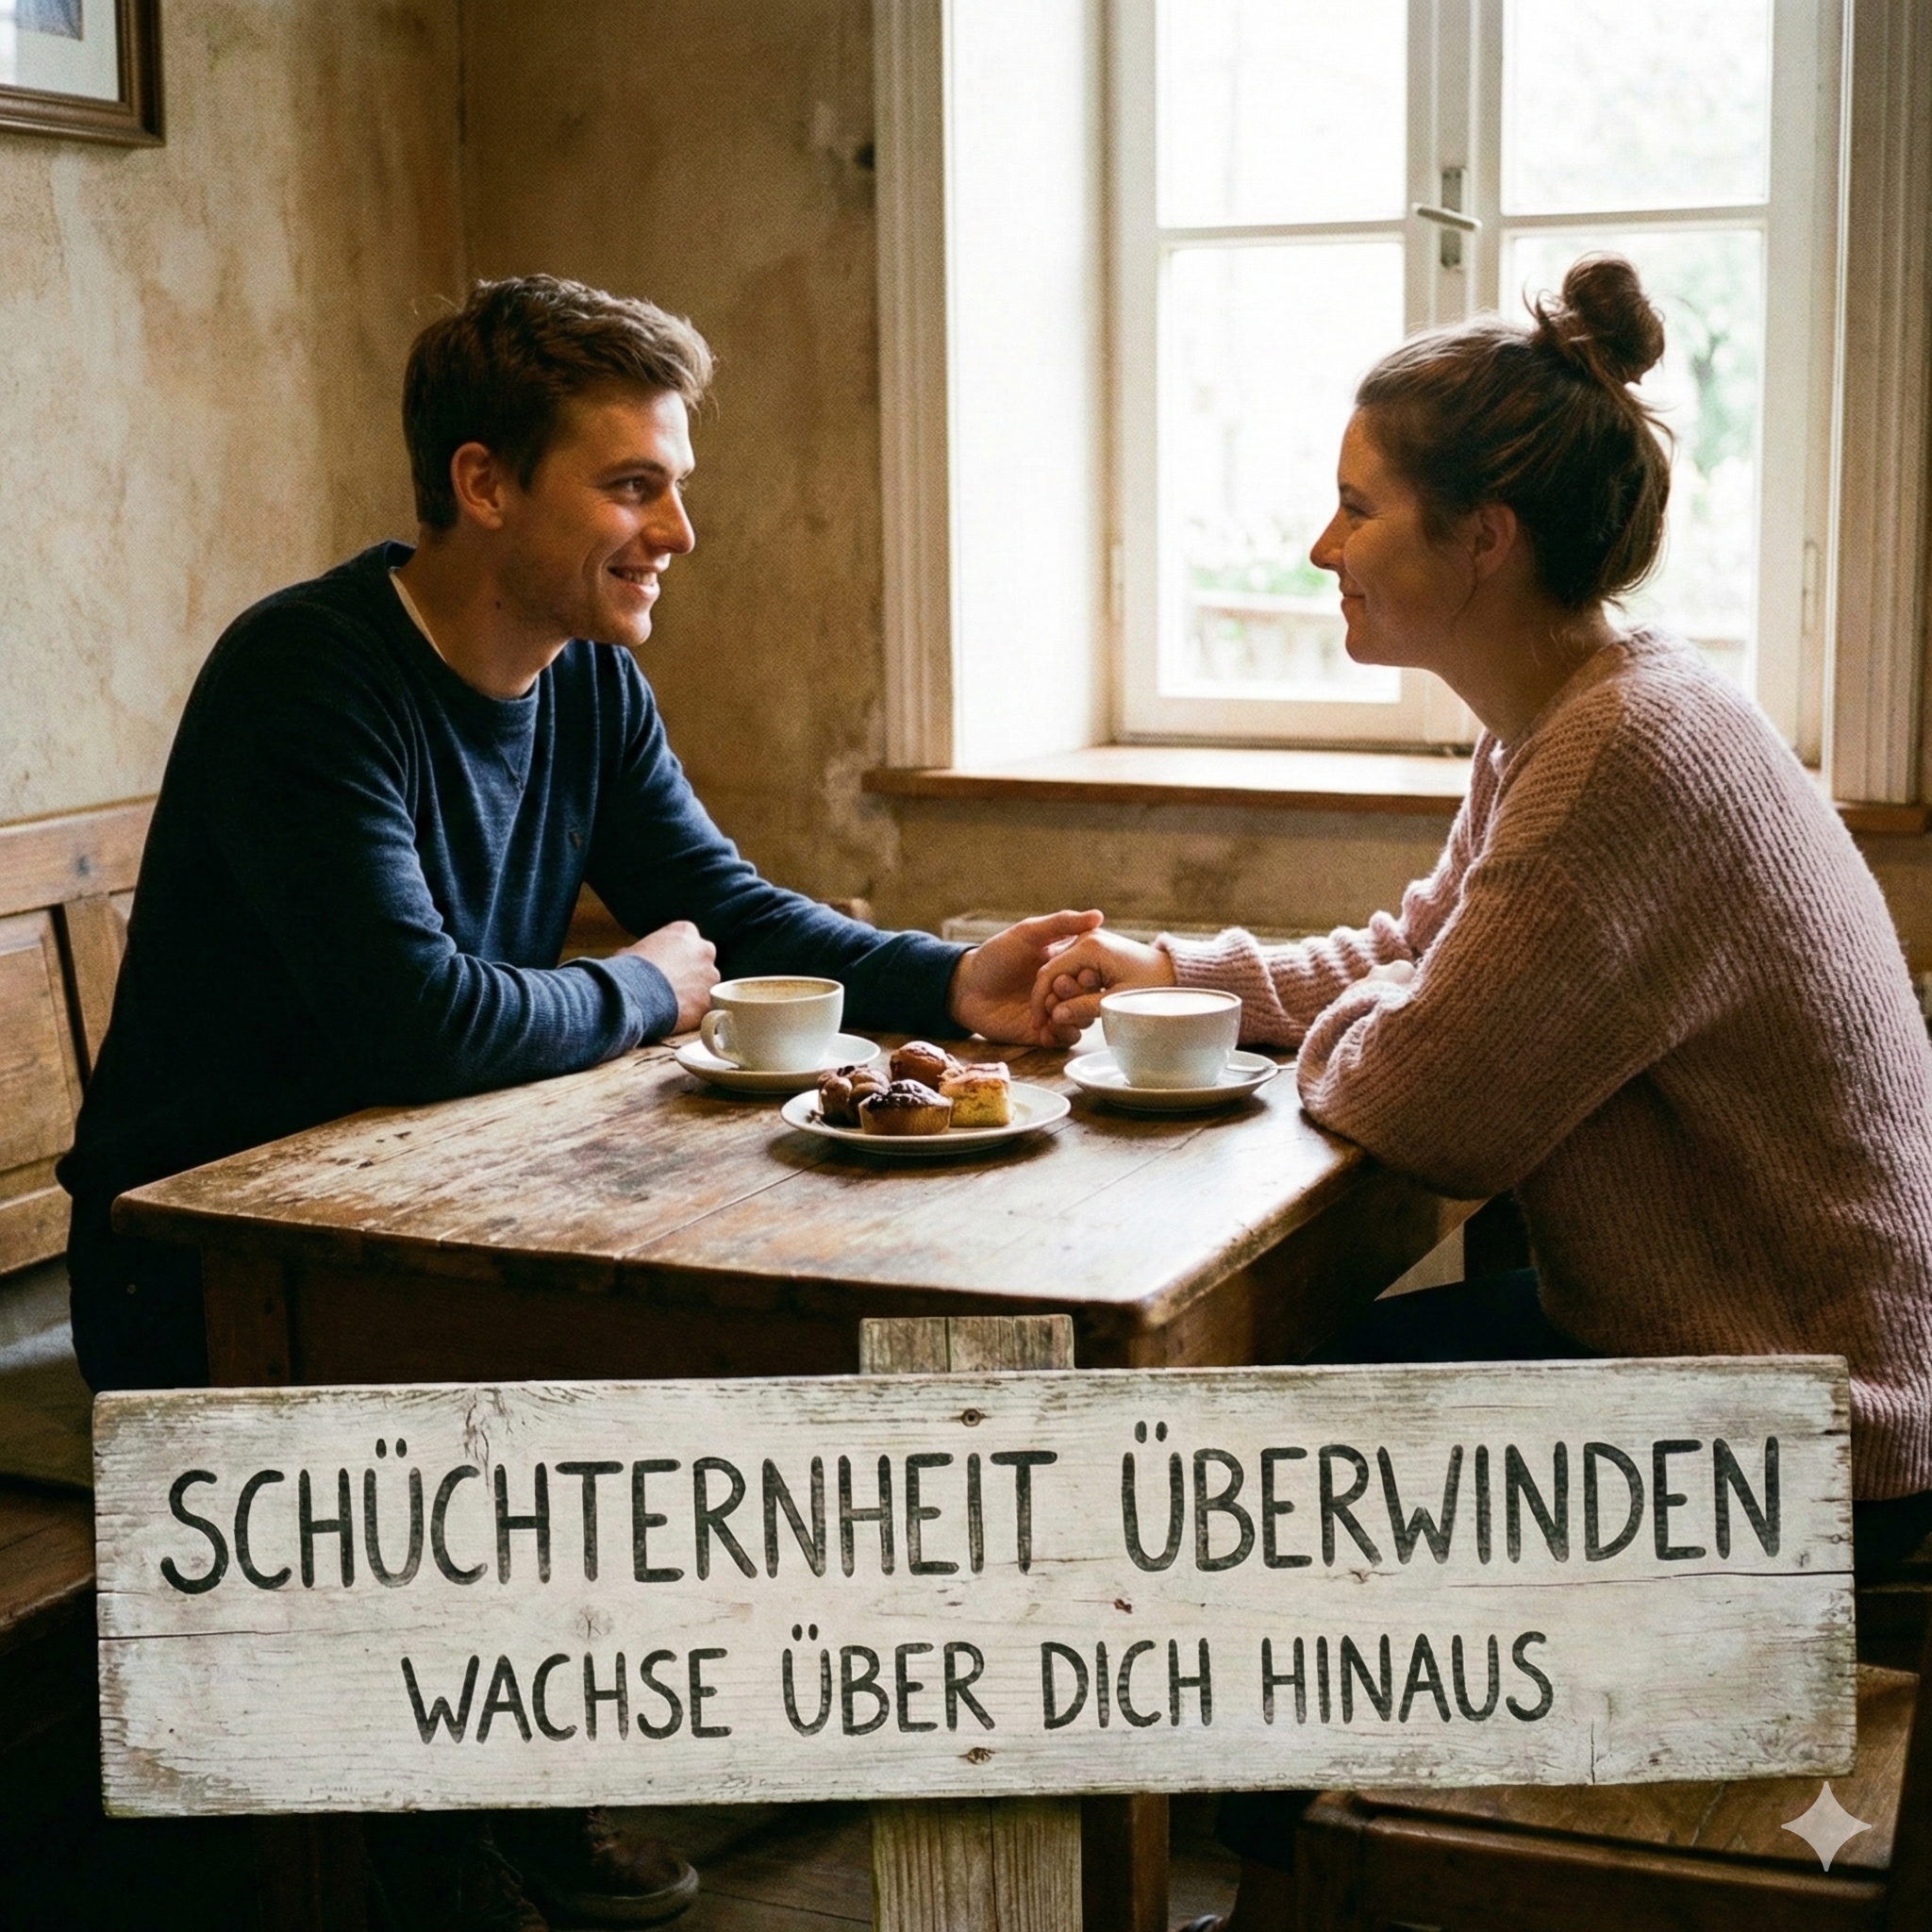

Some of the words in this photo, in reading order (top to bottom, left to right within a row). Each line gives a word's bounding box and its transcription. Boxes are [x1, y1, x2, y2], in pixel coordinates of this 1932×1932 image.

[160, 1438, 1058, 1594] SCHÜCHTERNHEIT
[1122, 1421, 1781, 1573] ÜBERWINDEN
[401, 1648, 732, 1745] WACHSE
[783, 1624, 995, 1739] ÜBER
[1041, 1637, 1212, 1730] DICH
[1261, 1631, 1554, 1726] HINAUS
